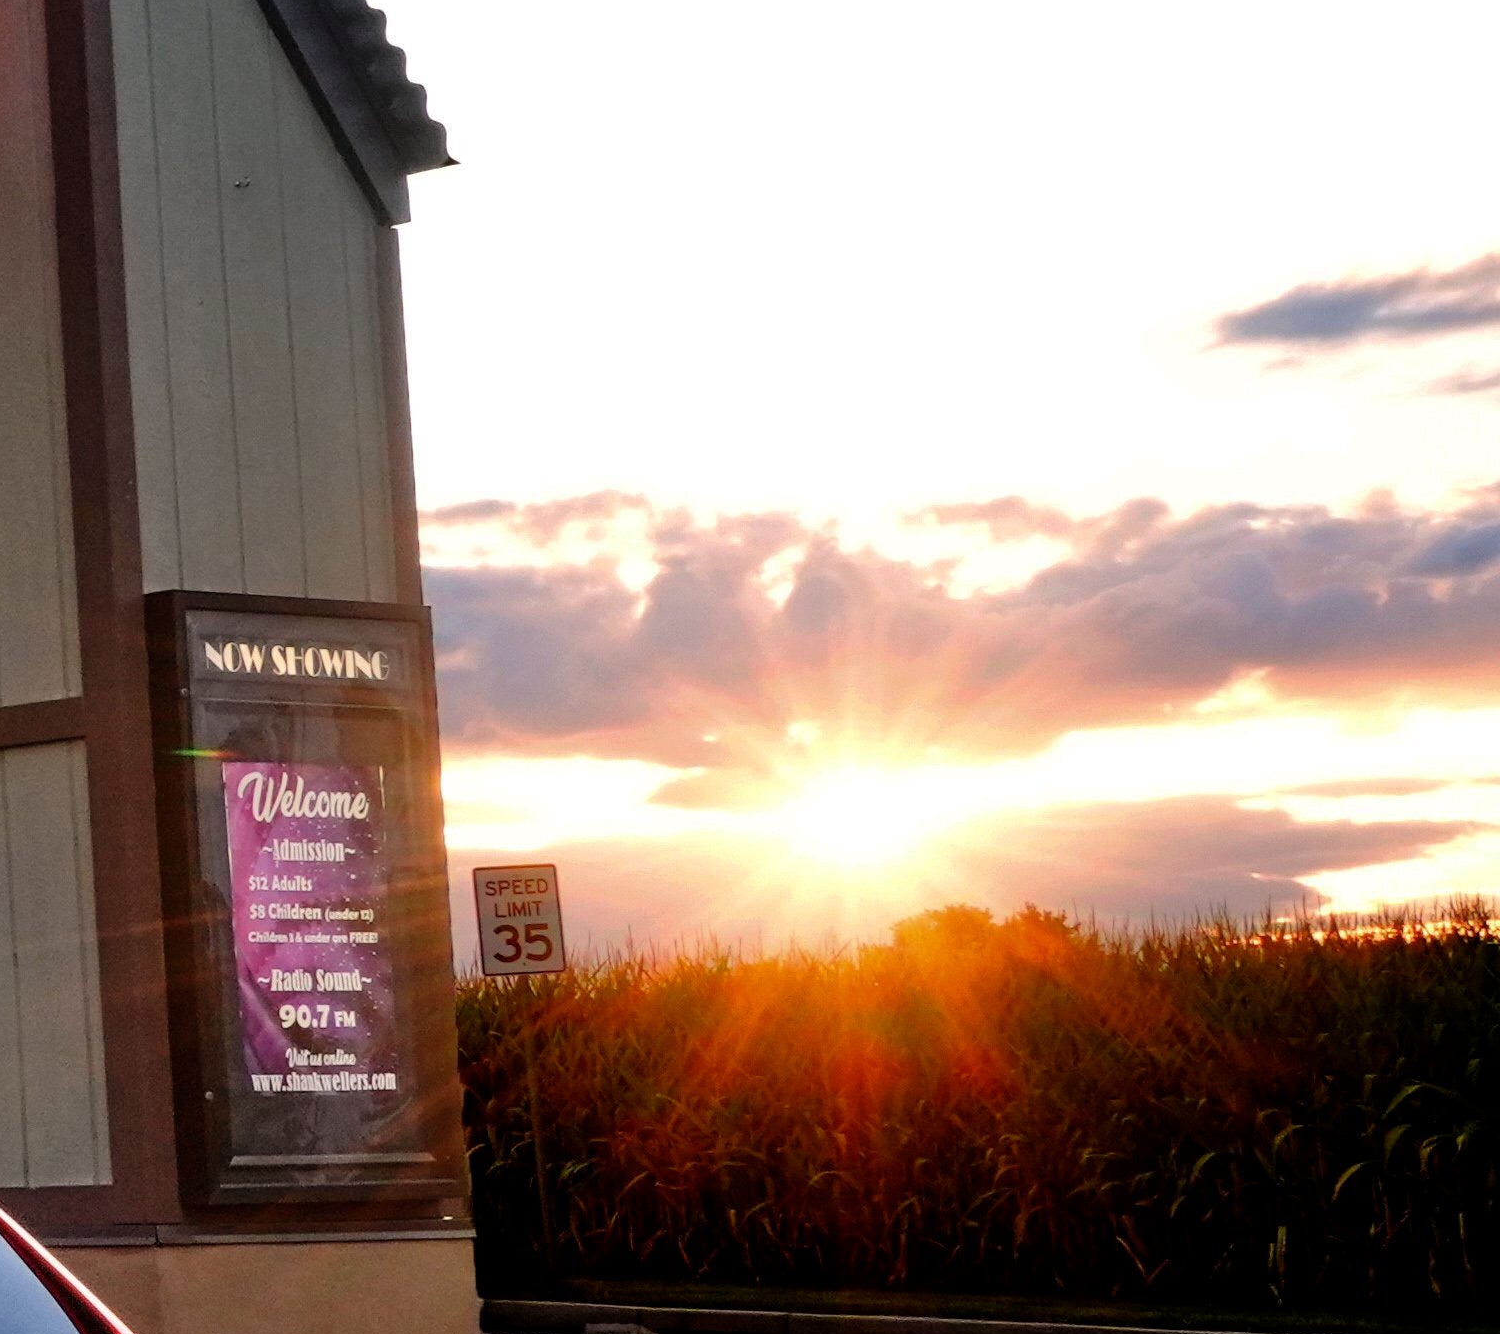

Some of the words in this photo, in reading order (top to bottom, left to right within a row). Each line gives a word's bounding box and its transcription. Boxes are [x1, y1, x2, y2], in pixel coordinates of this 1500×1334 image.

[204, 641, 266, 673] NOW
[271, 644, 390, 681] SHOWING
[237, 771, 370, 823] Welcome
[248, 875, 269, 892] $12
[272, 875, 313, 892] Adults
[485, 878, 548, 896] SPEED
[249, 904, 265, 920] $8
[268, 903, 322, 920] Children
[494, 900, 542, 918] LIMIT
[248, 931, 288, 944] Children
[304, 932, 331, 944] under
[493, 923, 553, 963] 35
[278, 1004, 330, 1029] 90.7
[334, 1011, 356, 1028] FM
[285, 1047, 310, 1068] Visit
[323, 1048, 357, 1066] online
[251, 1071, 397, 1092] www.shankweilers.com
